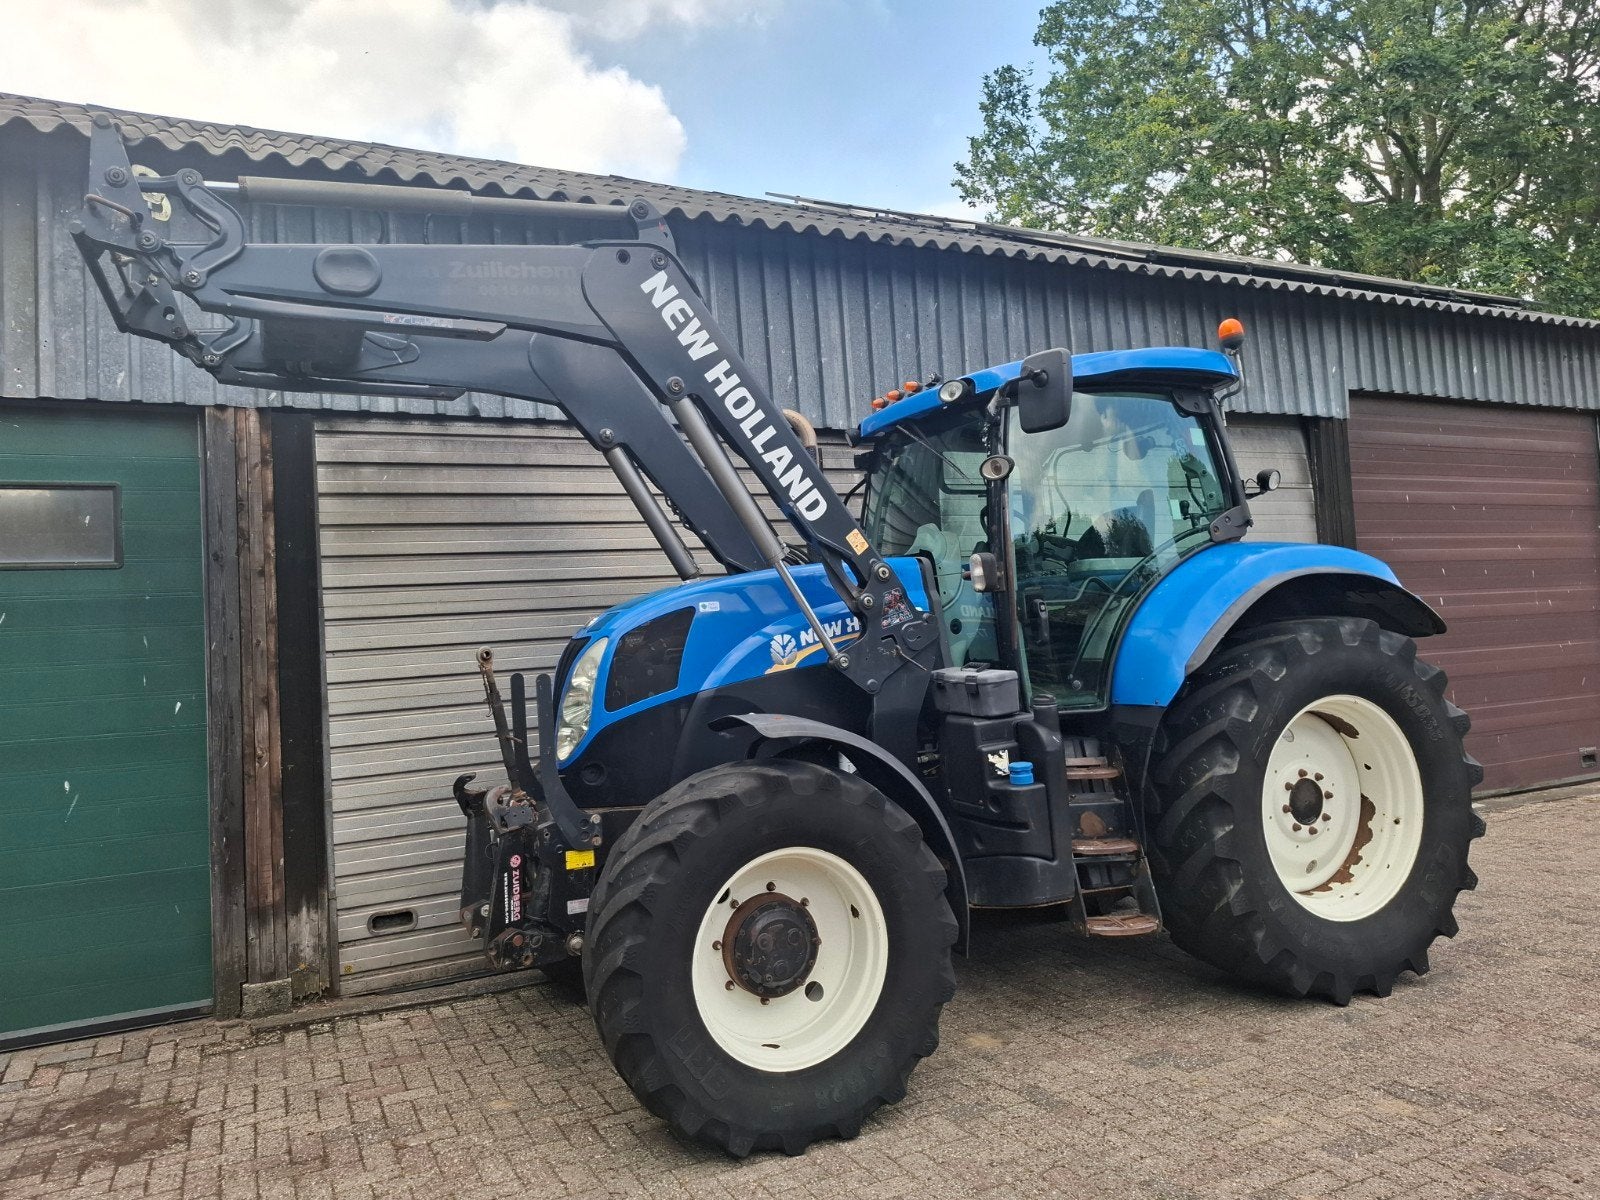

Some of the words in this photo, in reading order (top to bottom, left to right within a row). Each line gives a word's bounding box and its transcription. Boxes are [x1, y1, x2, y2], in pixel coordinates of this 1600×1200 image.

[640, 270, 719, 361] NEW
[704, 359, 828, 522] HOLLAND
[800, 619, 842, 646] NW
[512, 869, 521, 921] ZUIDBERG
